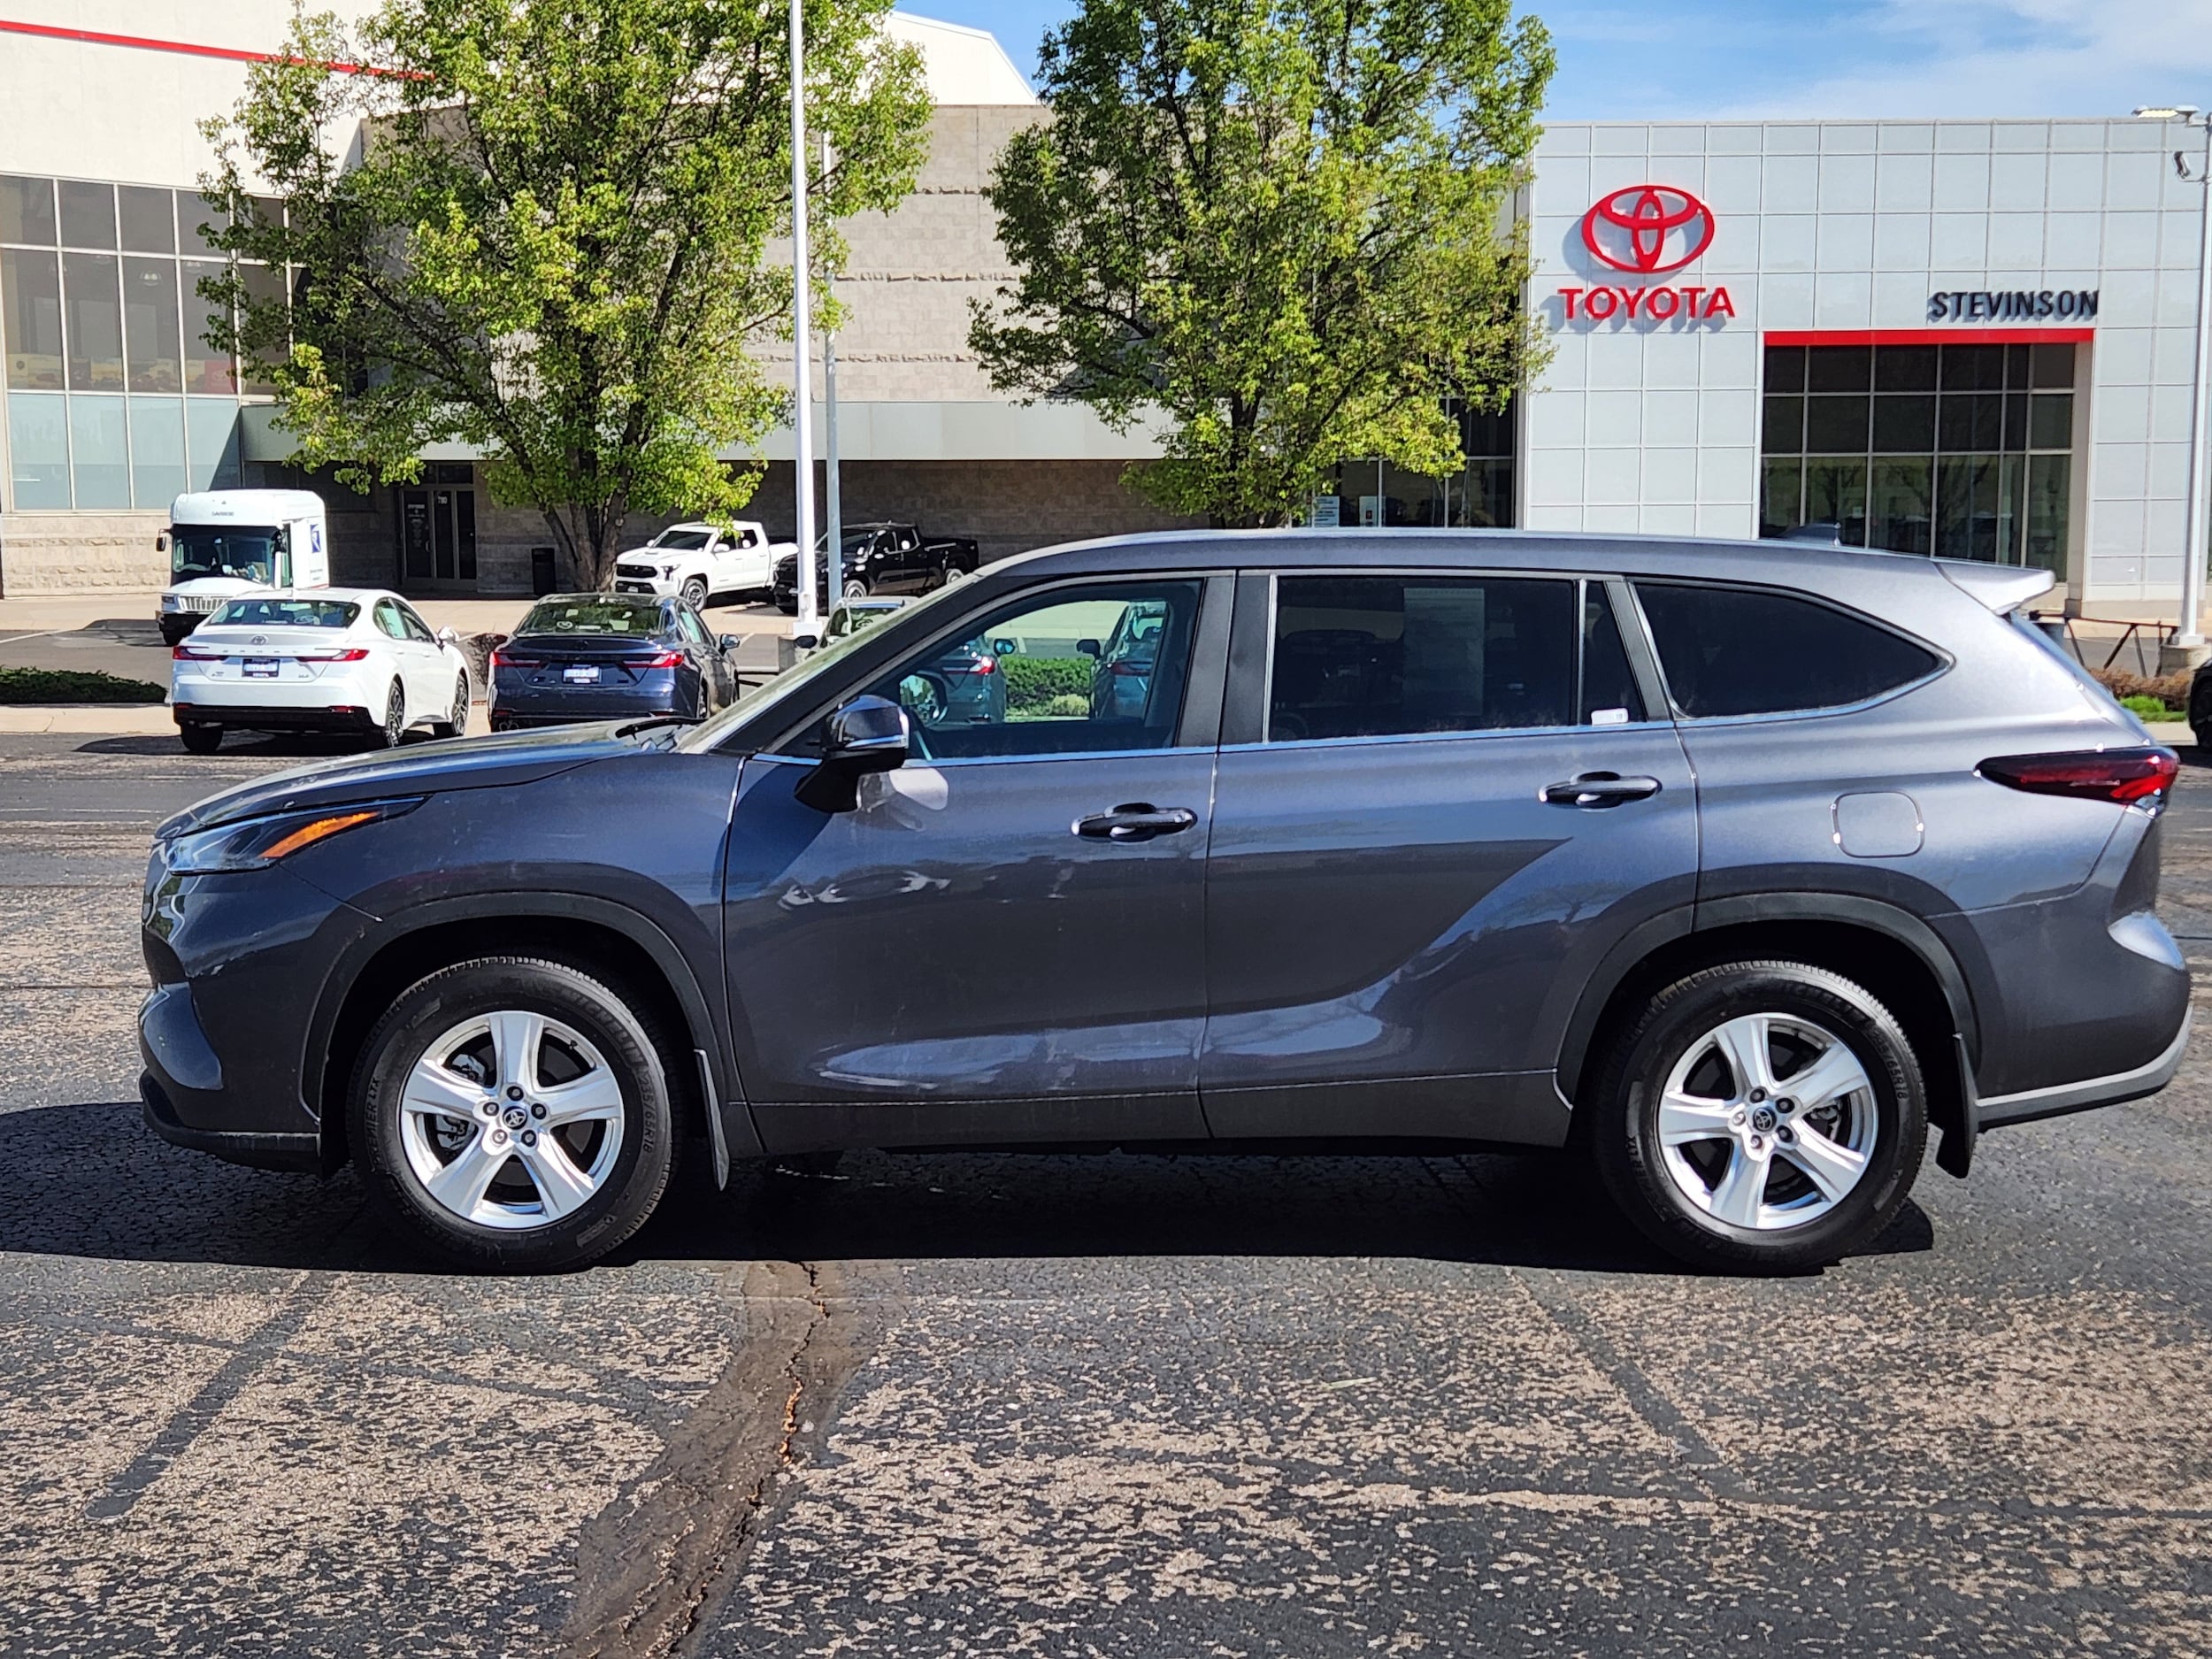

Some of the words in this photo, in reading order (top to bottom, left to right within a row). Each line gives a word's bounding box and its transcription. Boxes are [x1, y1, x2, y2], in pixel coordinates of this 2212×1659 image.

[1557, 286, 1735, 320] TOYOTA
[1932, 289, 2100, 318] STEVINSON
[368, 1077, 380, 1099] LTX
[637, 1071, 657, 1154] 235/65R18
